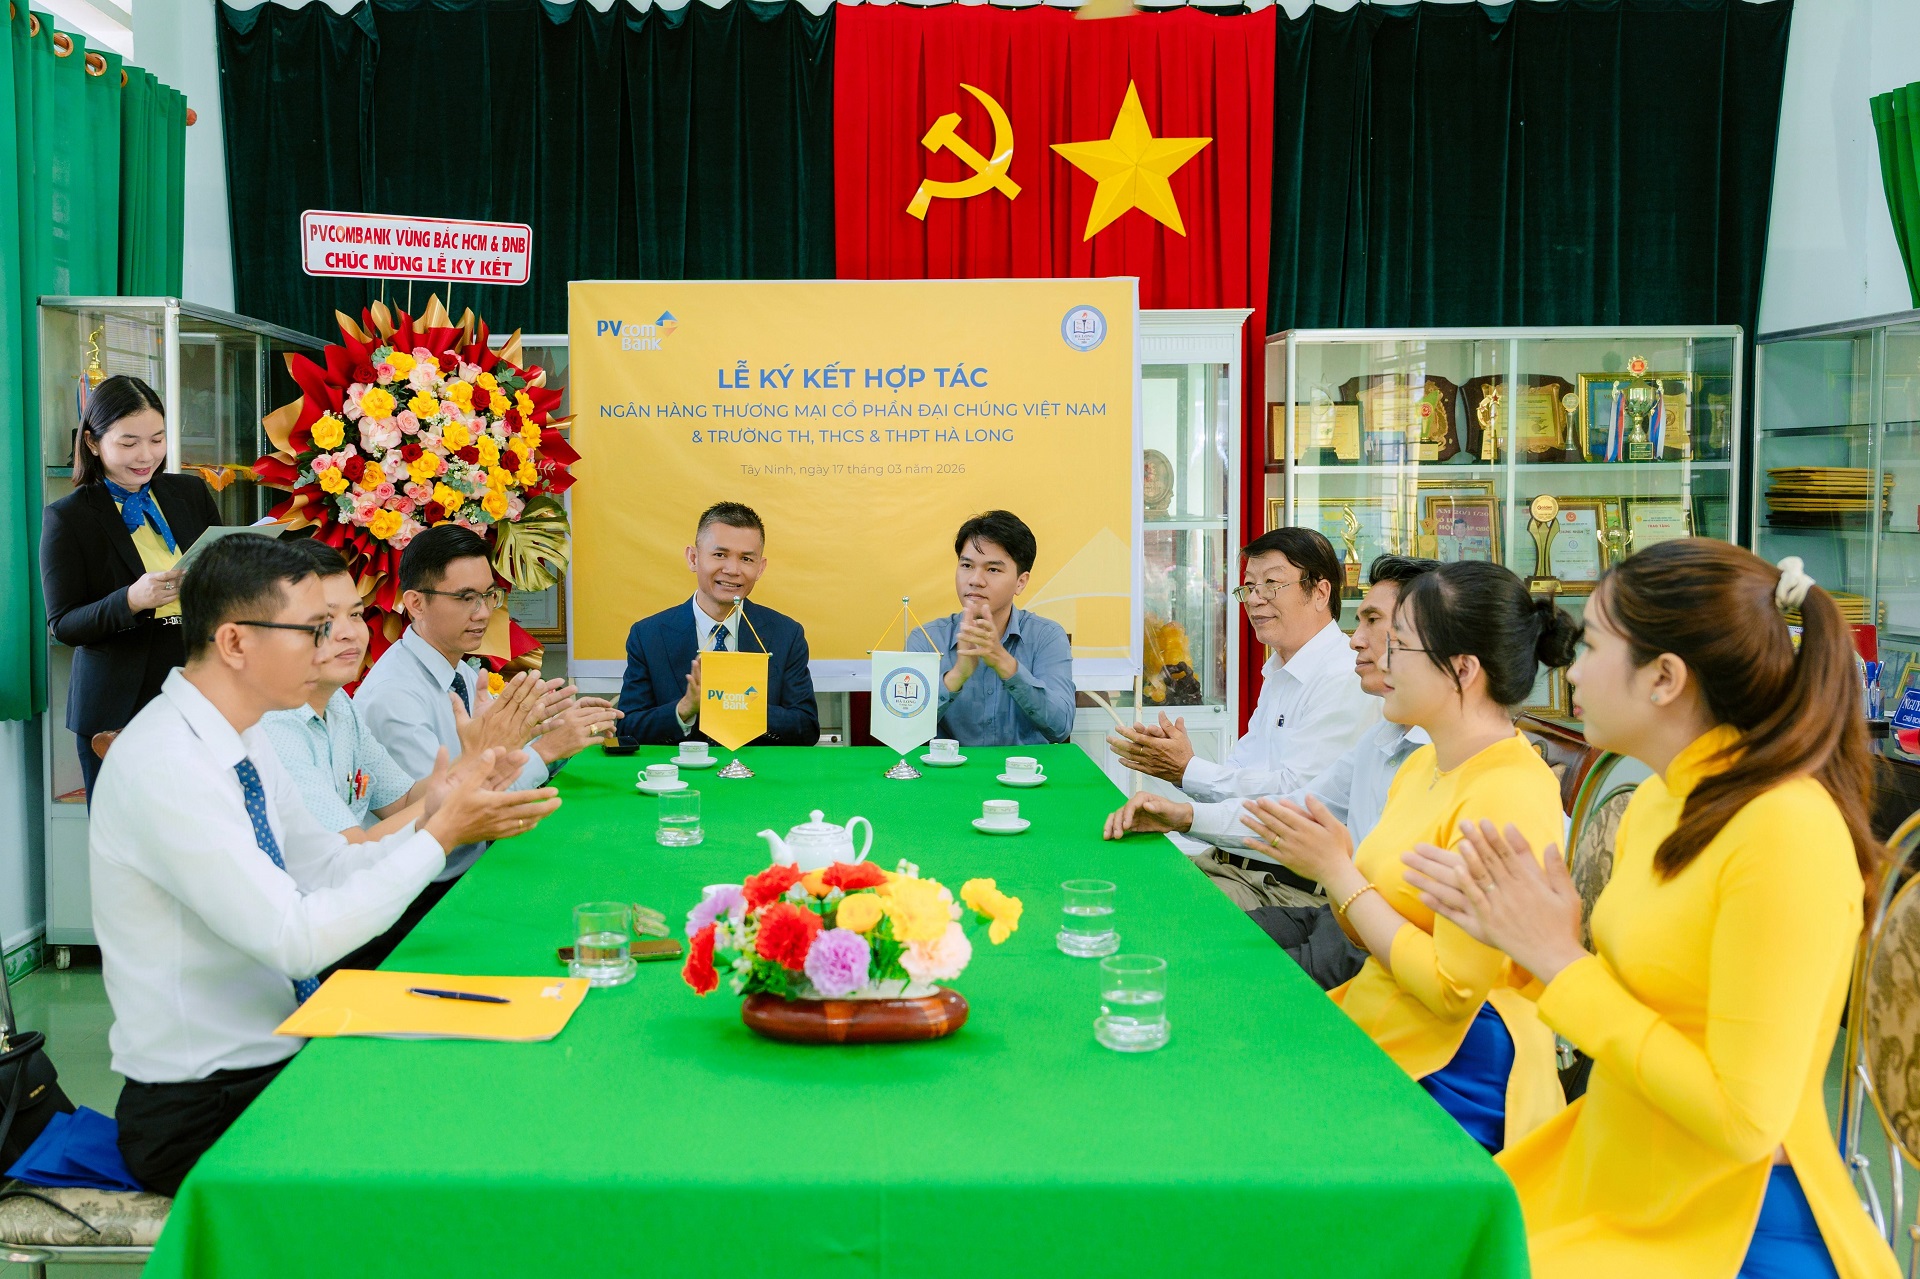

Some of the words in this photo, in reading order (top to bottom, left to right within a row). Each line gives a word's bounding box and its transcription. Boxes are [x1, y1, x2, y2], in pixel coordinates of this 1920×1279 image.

[310, 224, 391, 245] PVCOMBANK
[396, 227, 430, 248] VÙNG
[434, 226, 458, 249] BẮC
[462, 233, 487, 251] HCM
[491, 235, 498, 252] &
[502, 236, 525, 253] ĐNB
[325, 250, 368, 269] CHÚC
[374, 252, 422, 272] MỪNG
[428, 252, 446, 273] LỄ
[452, 257, 475, 274] KÝ
[480, 256, 512, 276] KẾT
[597, 320, 656, 337] PVcom
[621, 337, 662, 350] Bank
[718, 360, 750, 389] LỄ
[760, 363, 794, 389] KÝ
[803, 361, 856, 389] KẾT
[864, 364, 925, 393] HỢP
[934, 362, 988, 388] TÁC
[600, 402, 650, 418] NGÂN
[657, 402, 707, 418] HÀNG
[712, 402, 788, 418] THƯƠNG
[795, 404, 826, 420] MẠI
[832, 400, 857, 418] CỔ
[863, 400, 912, 417] PHẦN
[918, 403, 948, 420] ĐẠI
[953, 400, 1018, 417] CHÚNG
[1023, 400, 1060, 419] VIỆT
[1066, 403, 1106, 416] NAM
[691, 430, 703, 443] &
[707, 427, 782, 443] TRƯỜNG
[787, 430, 814, 445] TH,
[819, 429, 865, 443] THCS
[869, 429, 880, 443] &
[885, 429, 930, 442] THPT
[935, 426, 960, 442] HÀ
[965, 429, 1014, 442] LONG
[740, 464, 761, 476] Tây
[764, 464, 796, 476] Ninh,
[800, 464, 829, 476] ngày
[832, 464, 844, 474] 17
[847, 464, 884, 476] tháng
[887, 464, 902, 474] 03
[905, 464, 933, 474] năm
[936, 463, 966, 474] 2026
[723, 700, 748, 710] Bank
